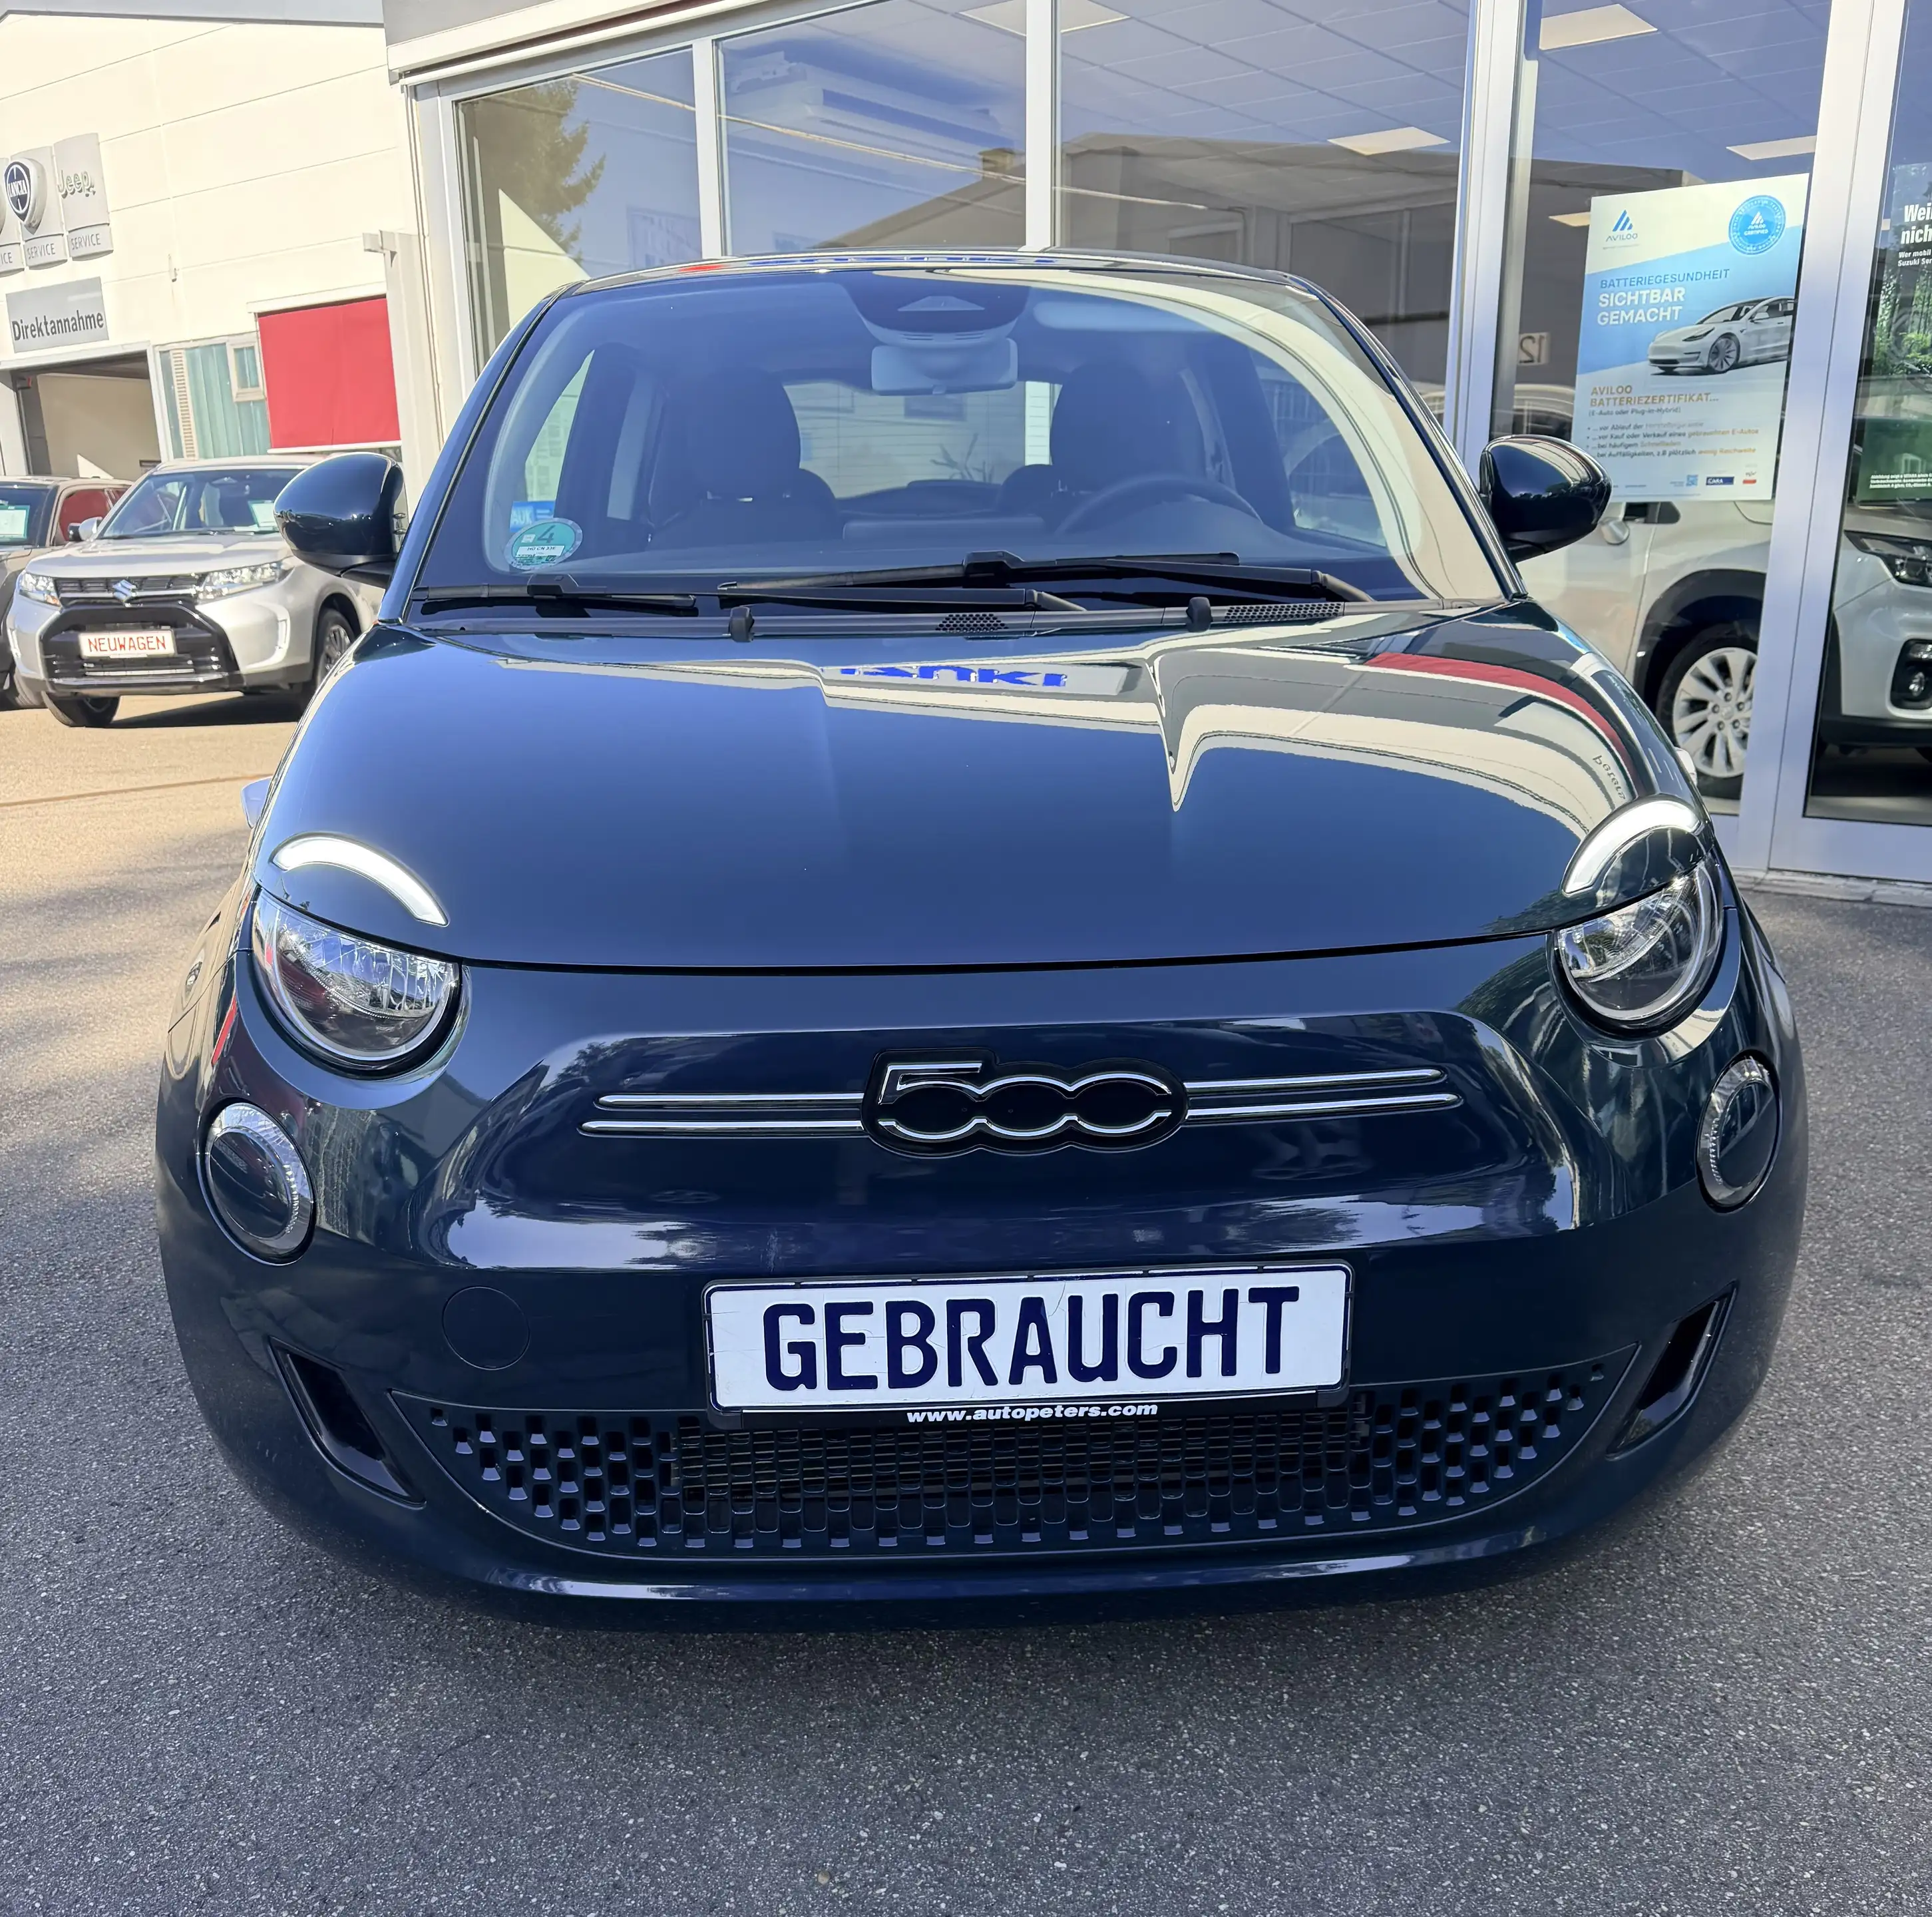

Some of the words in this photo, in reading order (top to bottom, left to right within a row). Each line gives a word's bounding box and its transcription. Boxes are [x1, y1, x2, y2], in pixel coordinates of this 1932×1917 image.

[58, 170, 94, 198] Jeep
[1905, 202, 1932, 222] Wei
[71, 234, 101, 250] SERVICE
[1605, 233, 1638, 242] AVILOO
[27, 243, 56, 260] SERVICE
[1897, 258, 1919, 267] Suzuki
[1600, 269, 1730, 289] BATTERIEGESUNDHEIT
[1599, 287, 1686, 308] SICHTBAR
[11, 310, 104, 341] Direktannahme
[1597, 306, 1682, 326] GEMACHT
[1591, 385, 1633, 395] AVILOO
[537, 525, 556, 544] 4
[88, 636, 166, 652] NEUWAGEN
[878, 1062, 1173, 1143] 500
[761, 1285, 1300, 1392] GEBRAUCHT
[906, 1404, 1158, 1422] www.autopeters.com
